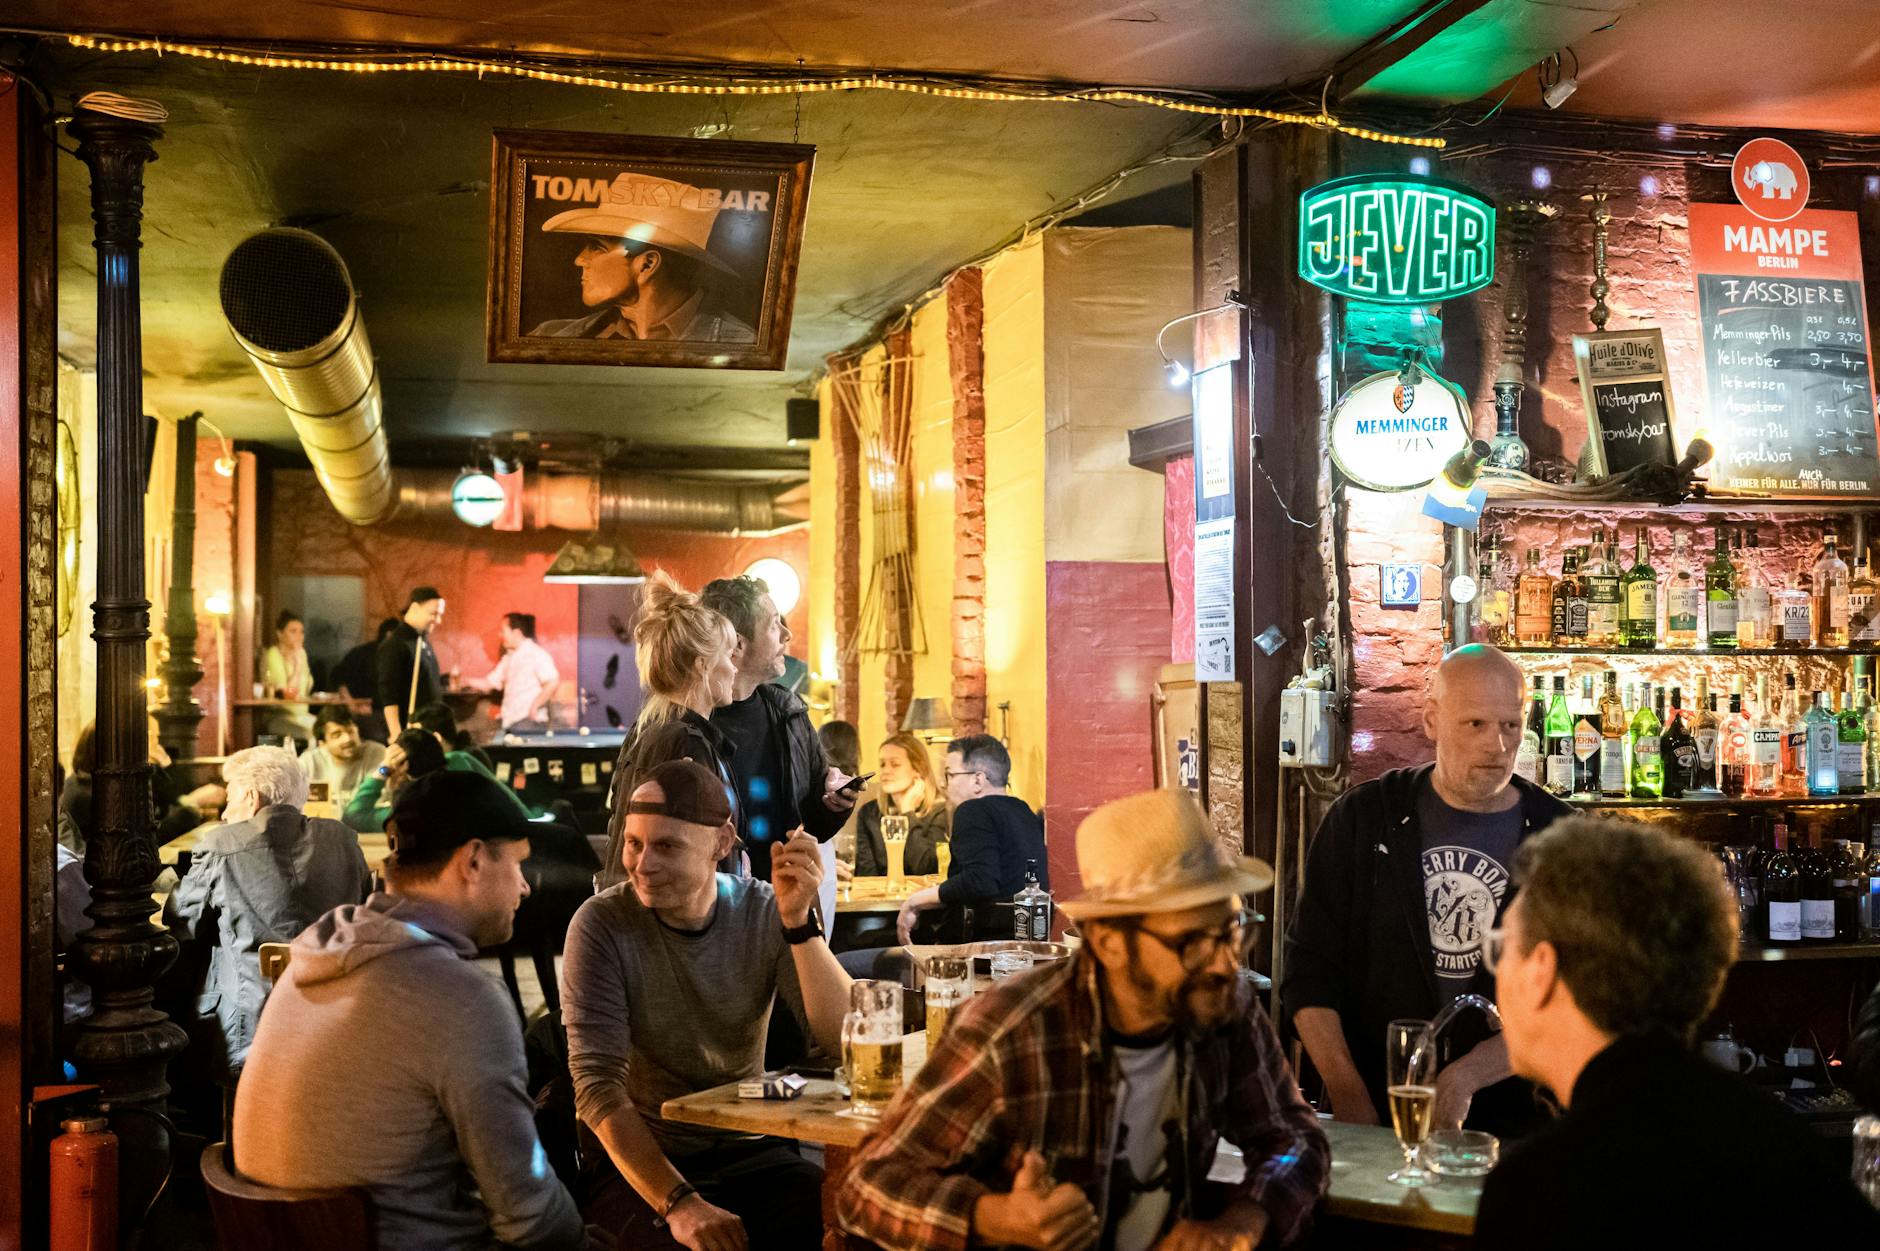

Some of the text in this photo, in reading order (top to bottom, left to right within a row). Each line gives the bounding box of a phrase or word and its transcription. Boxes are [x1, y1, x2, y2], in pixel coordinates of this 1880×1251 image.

[531, 174, 770, 212] TOMSKY BAR
[1307, 189, 1489, 296] JEVER
[1723, 225, 1829, 257] MAMPE
[1757, 255, 1799, 269] BERLIN
[1720, 280, 1846, 306] FASSBIERE
[1769, 324, 1792, 342] Pils
[1589, 344, 1618, 367] Huile
[1717, 348, 1781, 369] Kellerbier
[1720, 373, 1786, 392] Hefeweizen
[1596, 387, 1663, 415] Instagram
[1356, 417, 1449, 435] MEMMINGER
[1600, 419, 1667, 445] tomskybar
[1767, 421, 1789, 439] Pils
[1761, 477, 1778, 490] FÜR
[1779, 479, 1800, 490] ALLE.
[1839, 481, 1871, 491] BERLIN.
[1798, 469, 1823, 481] AUCH
[1575, 736, 1599, 745] VERNA
[1422, 851, 1508, 908] ERRY BOM
